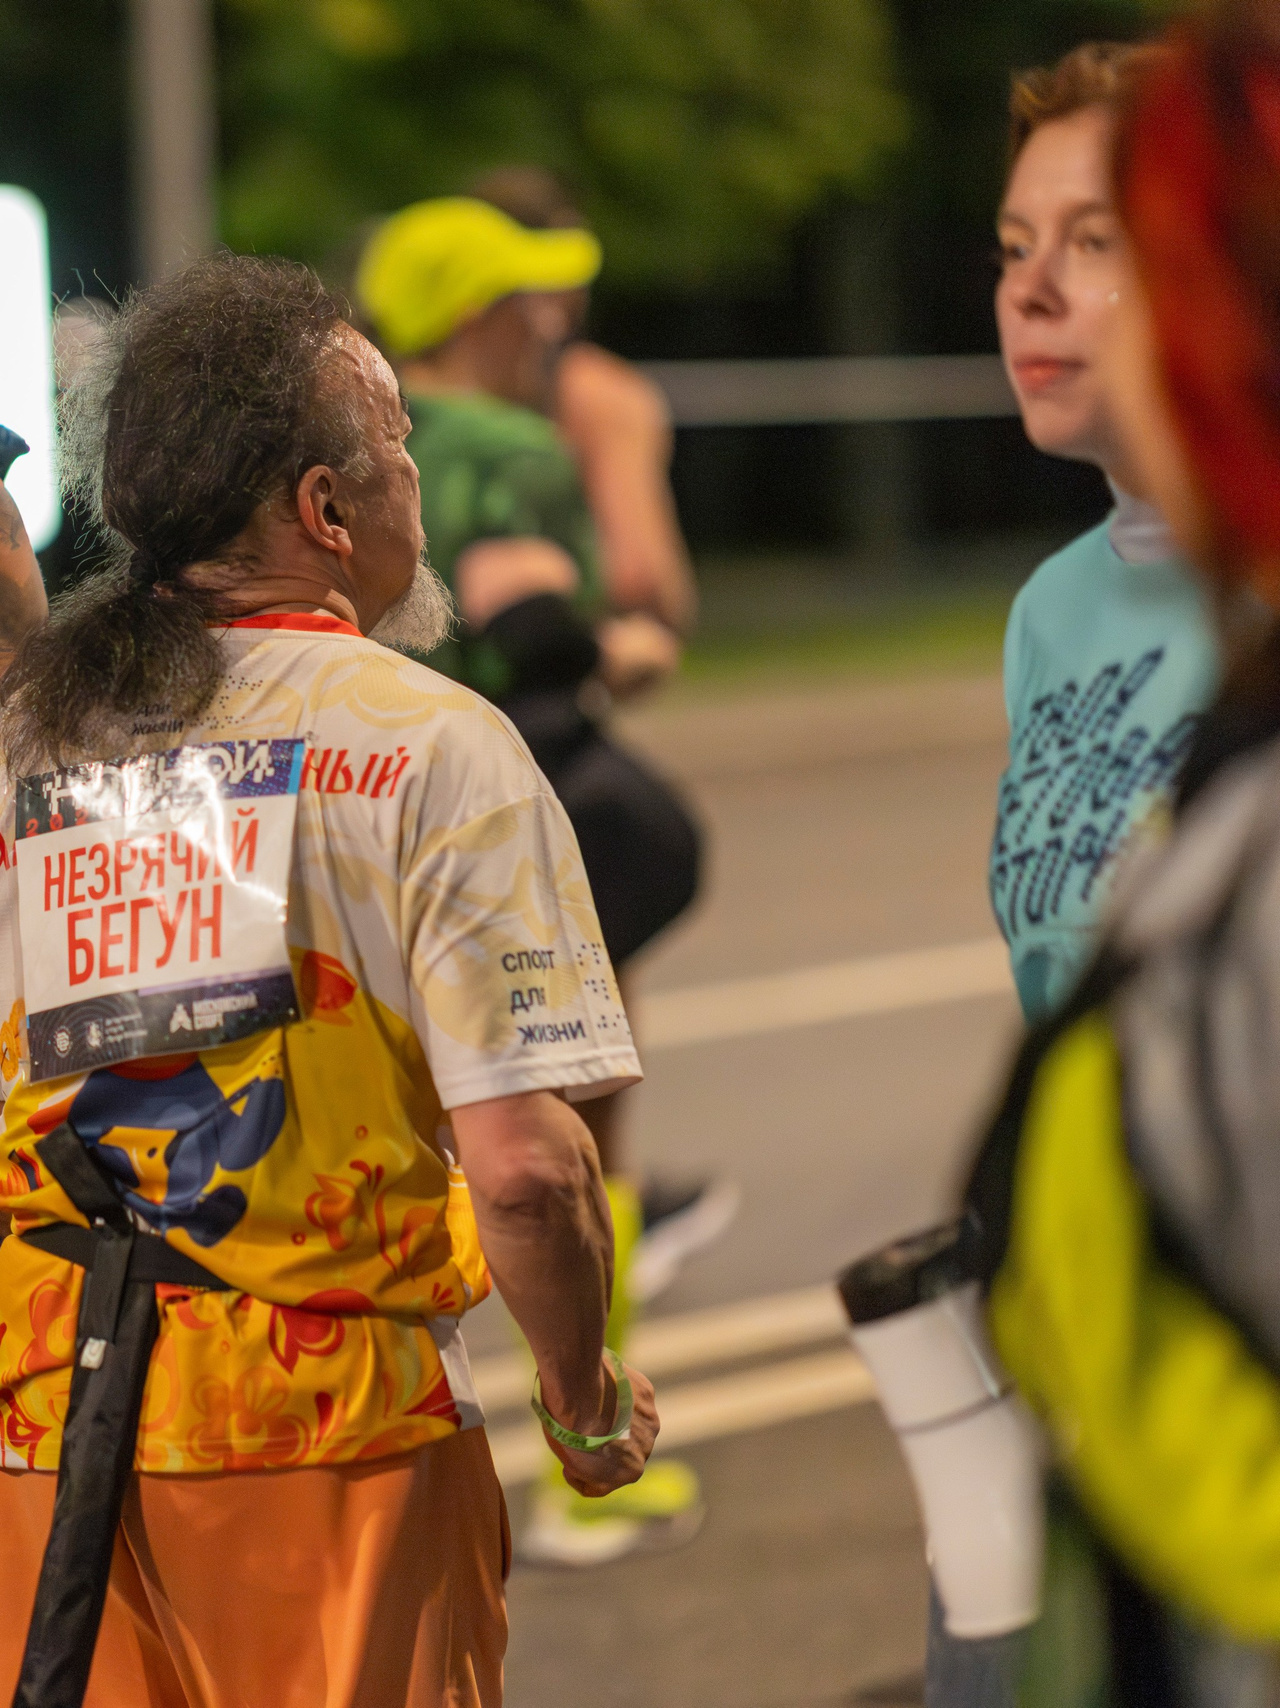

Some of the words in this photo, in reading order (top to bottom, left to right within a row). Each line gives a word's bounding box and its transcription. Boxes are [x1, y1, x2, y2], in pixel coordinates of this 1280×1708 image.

[44, 807, 259, 911] НЕЗРЯЧИЙ
[67, 884, 222, 986] БЕГУН
[518, 1019, 586, 1046] ЖИЗНИ
